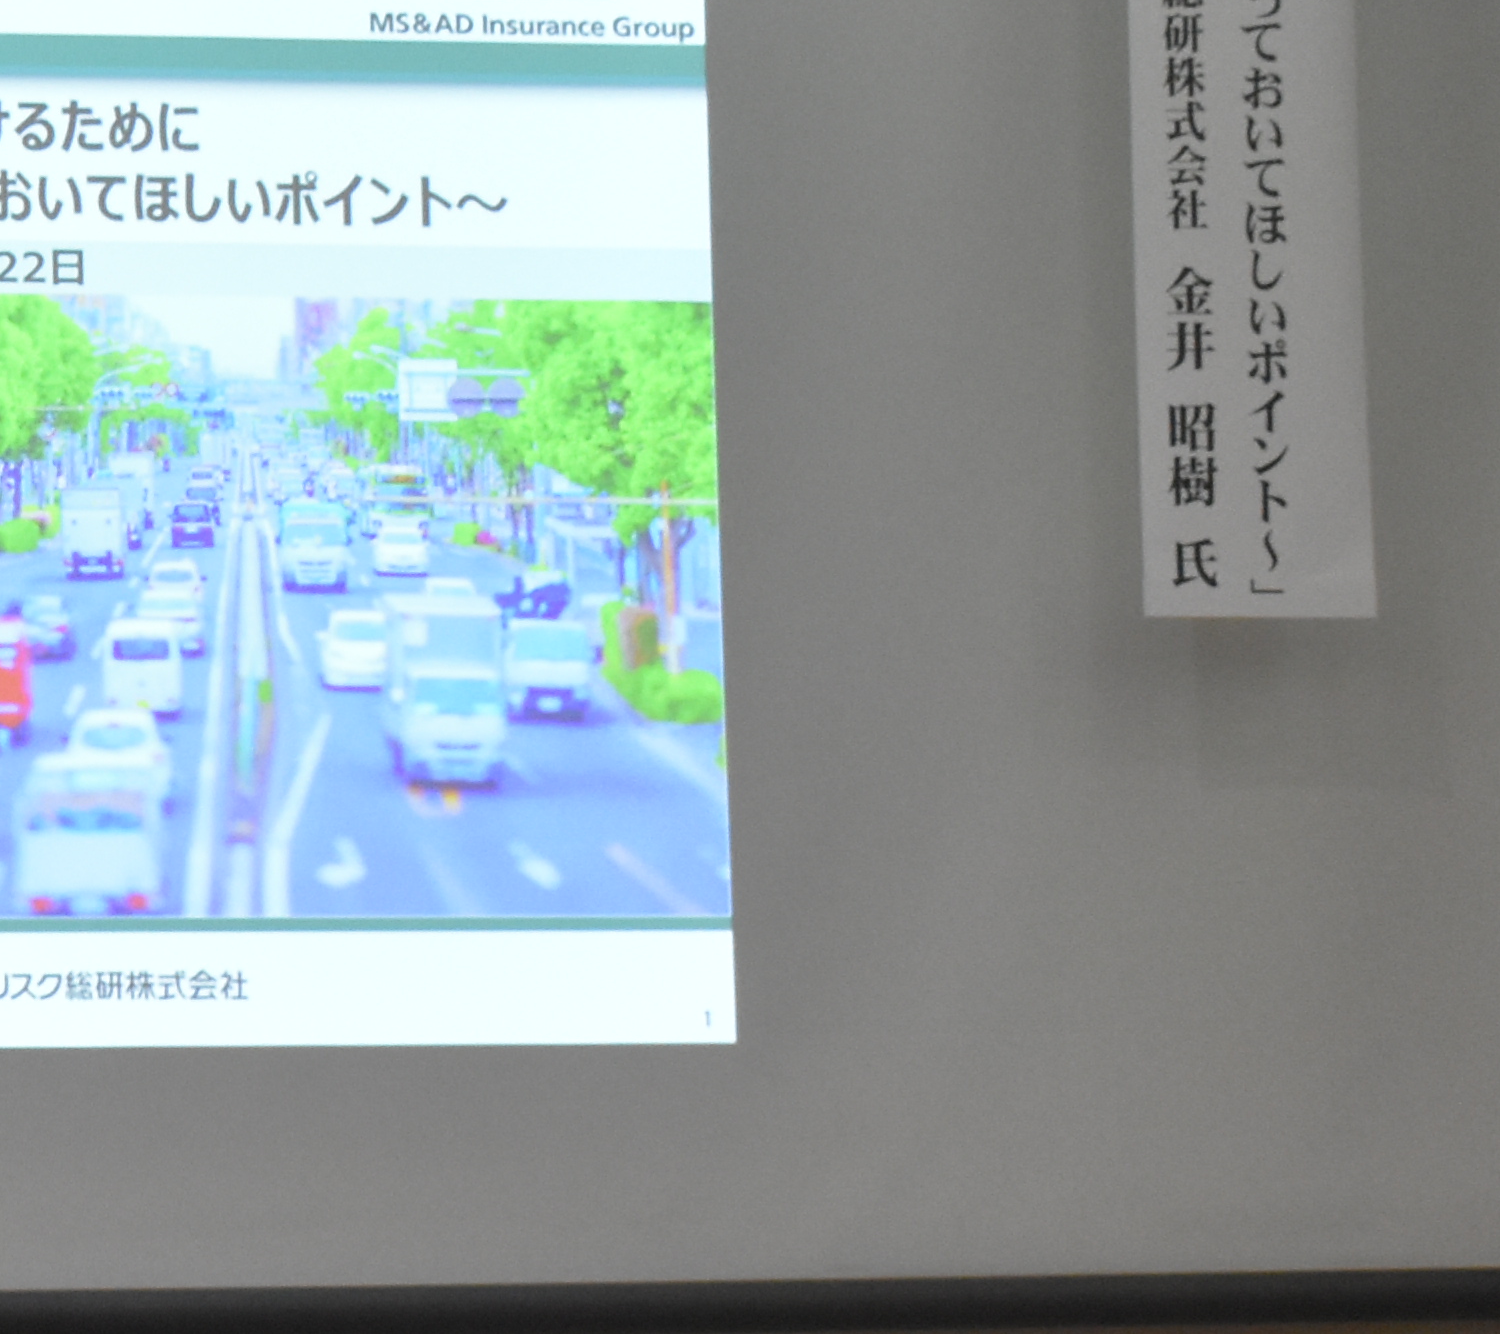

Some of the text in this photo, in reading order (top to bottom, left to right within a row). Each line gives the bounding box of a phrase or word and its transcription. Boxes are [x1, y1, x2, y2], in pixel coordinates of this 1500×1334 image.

[368, 12, 696, 43] MS&AD Insurance Group
[1165, 266, 1215, 373] 金井
[1166, 402, 1218, 508] 昭樹
[1171, 537, 1218, 590] 氏
